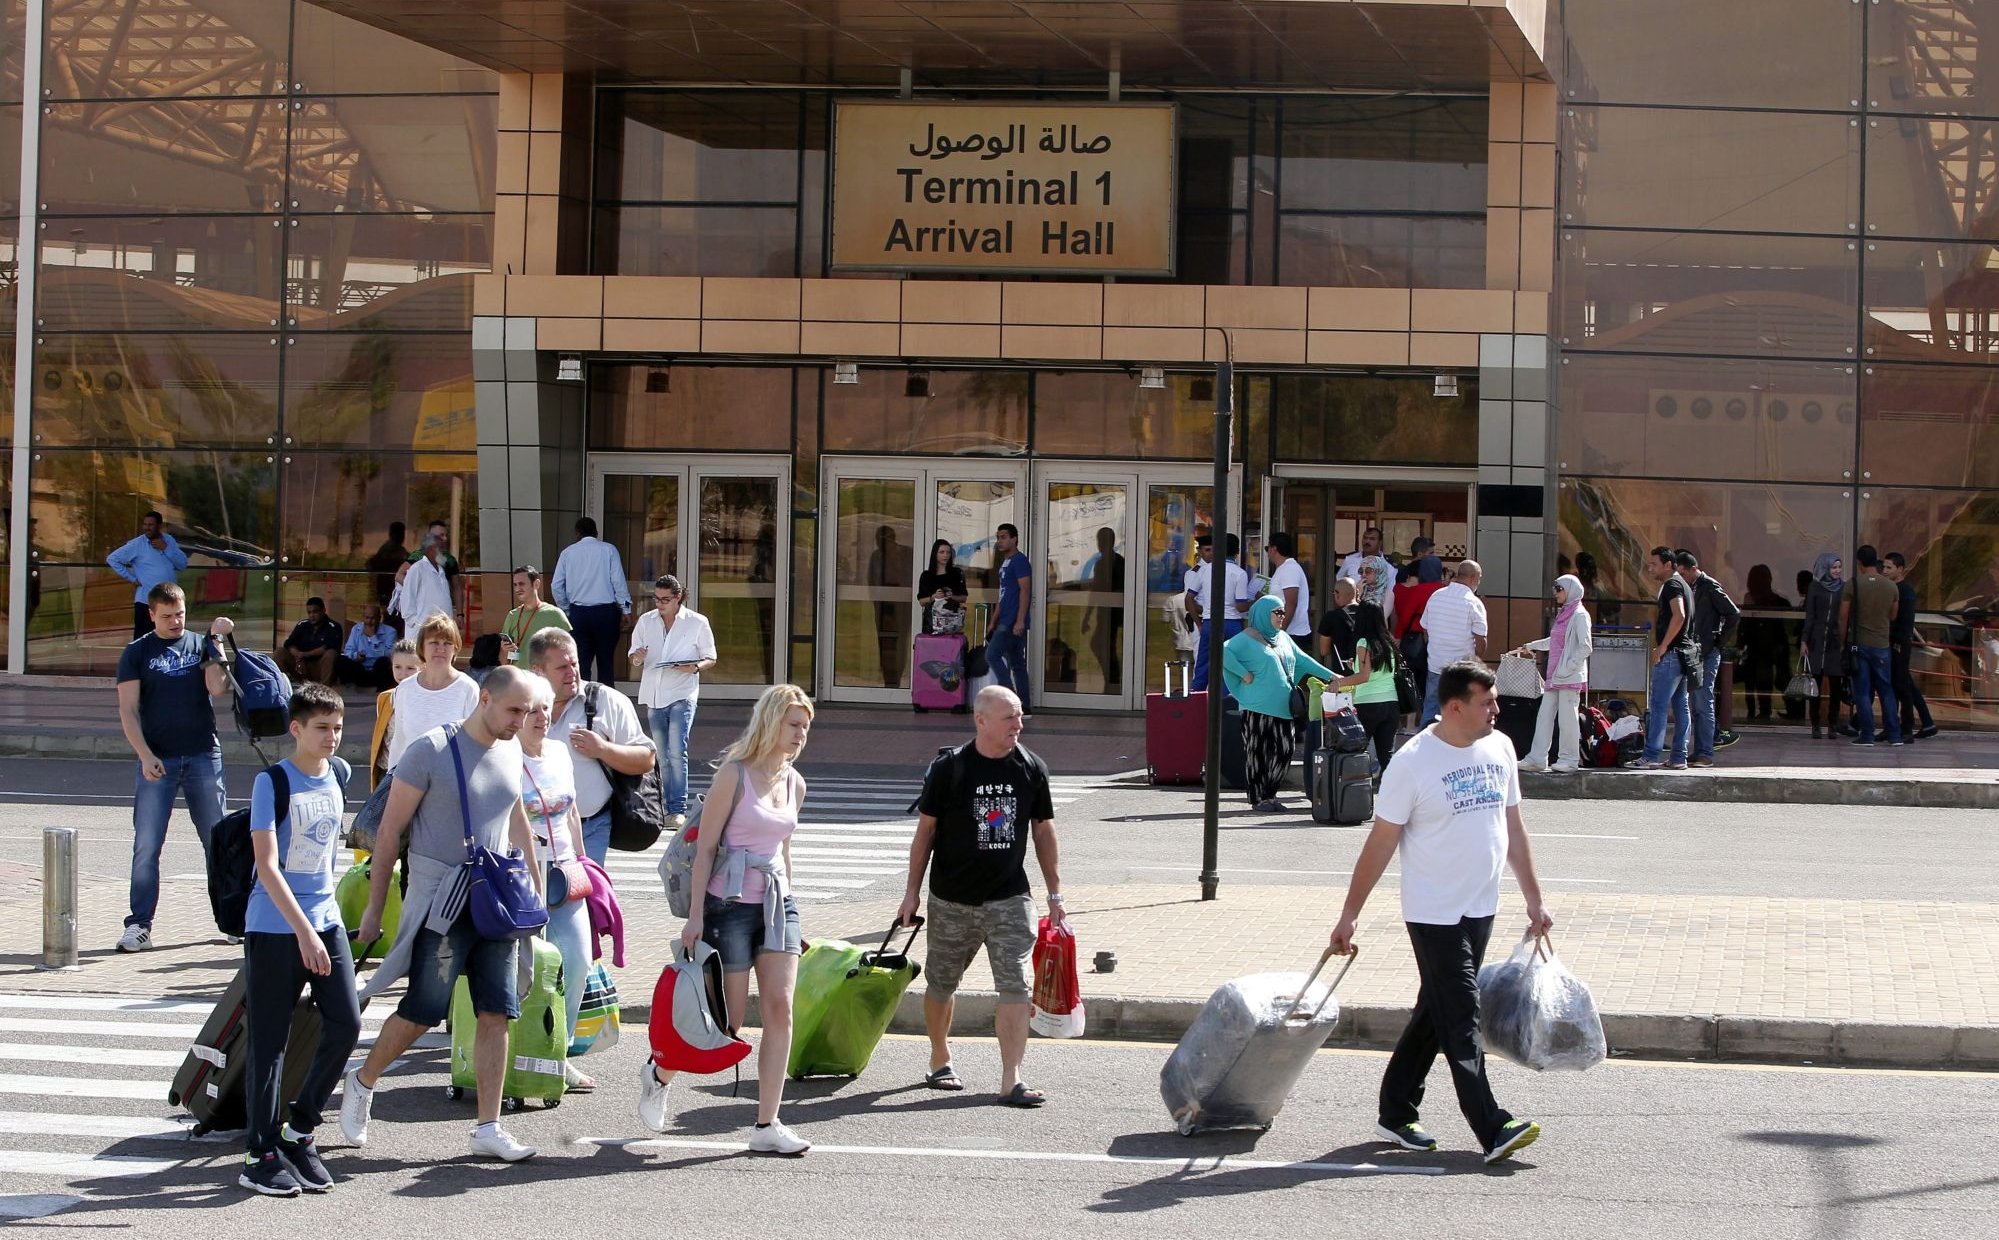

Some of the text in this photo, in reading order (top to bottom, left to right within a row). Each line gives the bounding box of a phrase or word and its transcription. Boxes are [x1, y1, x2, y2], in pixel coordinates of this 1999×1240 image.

[909, 122, 1112, 161] صالة الوصول
[896, 168, 1111, 206] Terminal 1
[883, 218, 1115, 256] Arrival Hall
[1453, 798, 1474, 810] CAST
[988, 842, 1011, 850] KOREA
